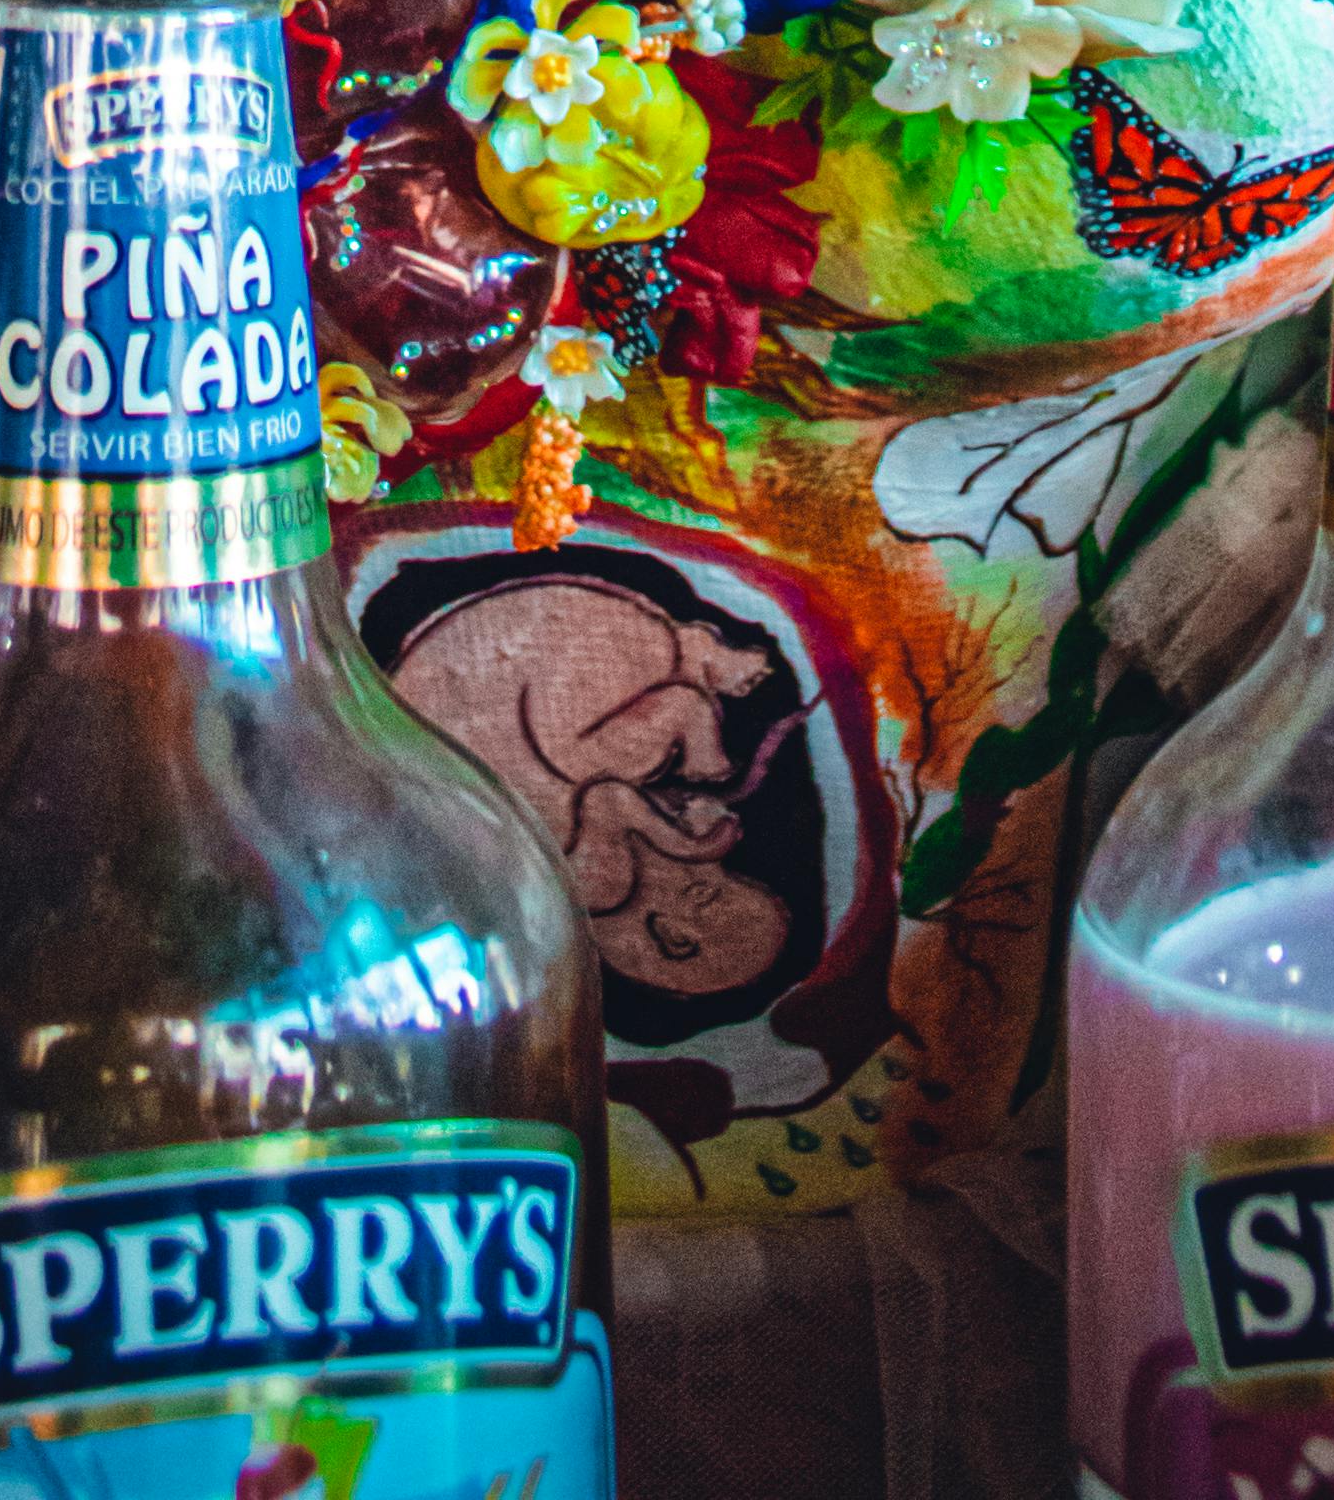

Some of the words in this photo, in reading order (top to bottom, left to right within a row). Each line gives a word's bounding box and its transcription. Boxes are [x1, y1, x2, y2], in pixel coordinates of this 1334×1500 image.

[64, 82, 266, 143] SPEY'S
[5, 176, 129, 206] COCTEL
[144, 163, 296, 203] PREARAD
[62, 211, 272, 319] PIÑA
[30, 429, 151, 463] SERVIR
[164, 424, 241, 461] BIEN
[250, 406, 302, 452] FRÍO
[52, 508, 85, 550] DE
[95, 507, 160, 552] ESTE
[167, 491, 294, 550] PRODUCTO
